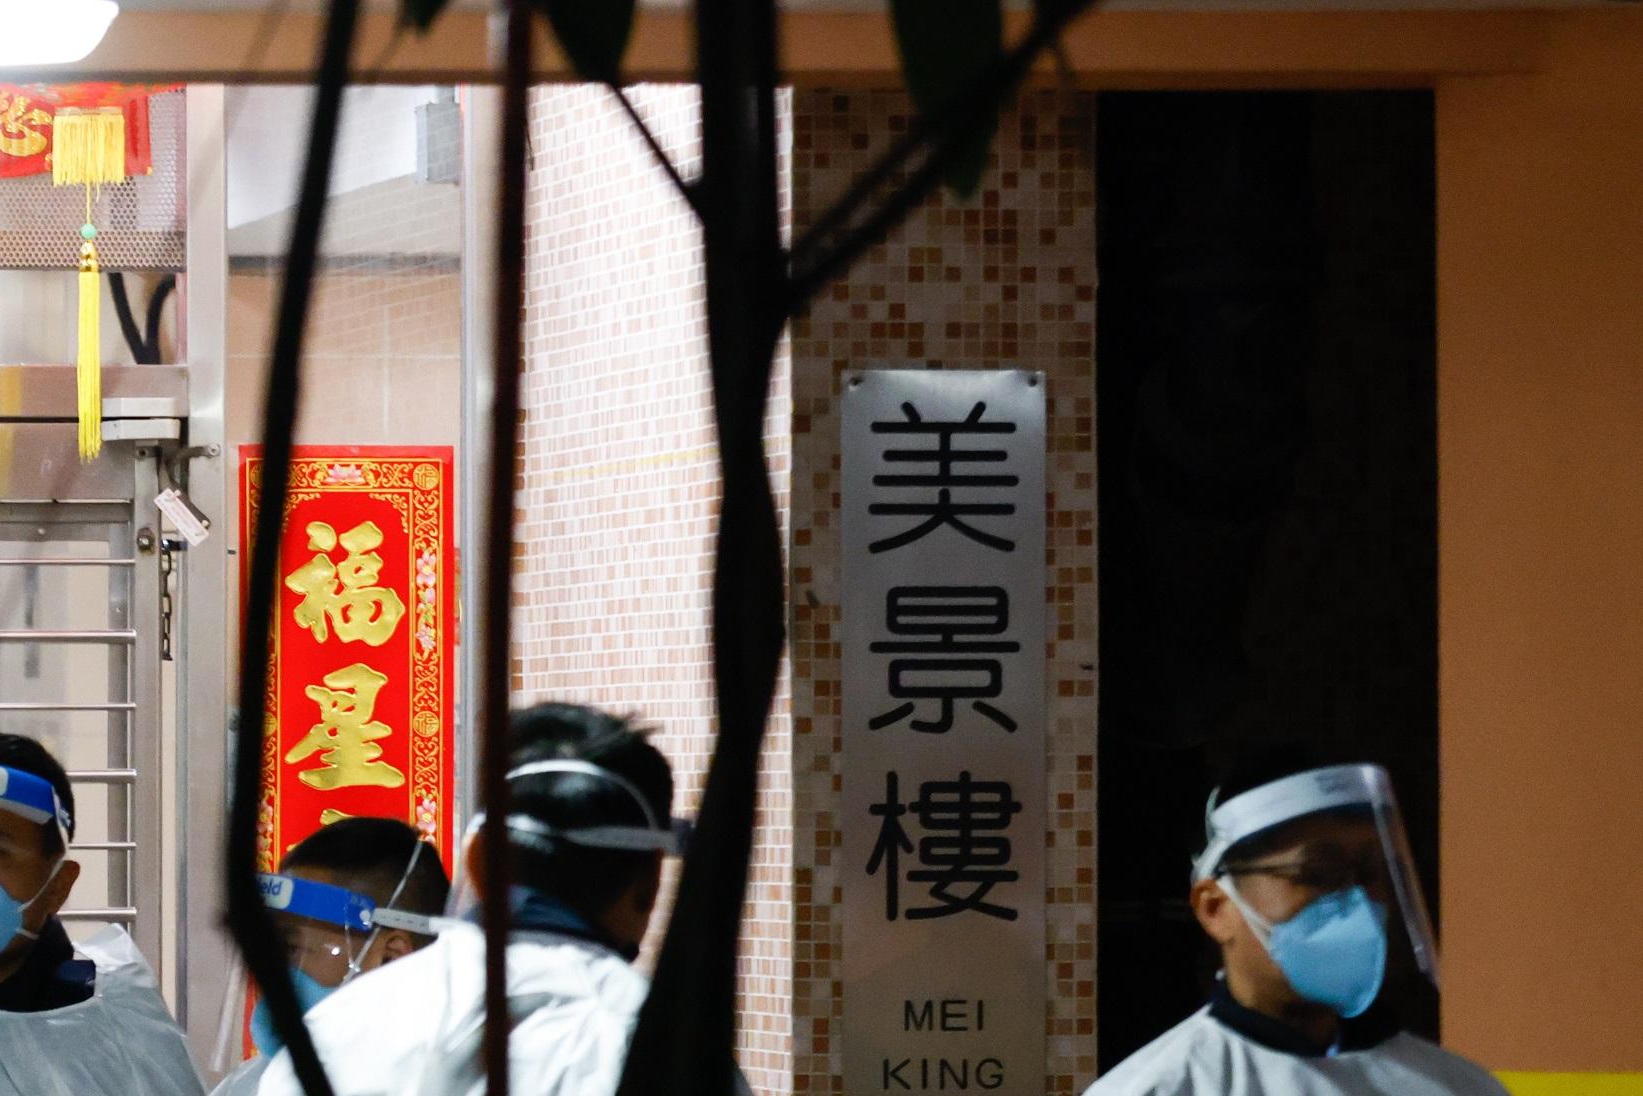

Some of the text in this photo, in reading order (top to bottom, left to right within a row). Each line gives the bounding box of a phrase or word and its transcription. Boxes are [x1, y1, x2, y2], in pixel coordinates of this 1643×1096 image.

[285, 521, 405, 826] 福星
[867, 401, 1022, 922] 美景樓
[883, 1058, 1004, 1090] KING
[904, 999, 984, 1032] MEI
